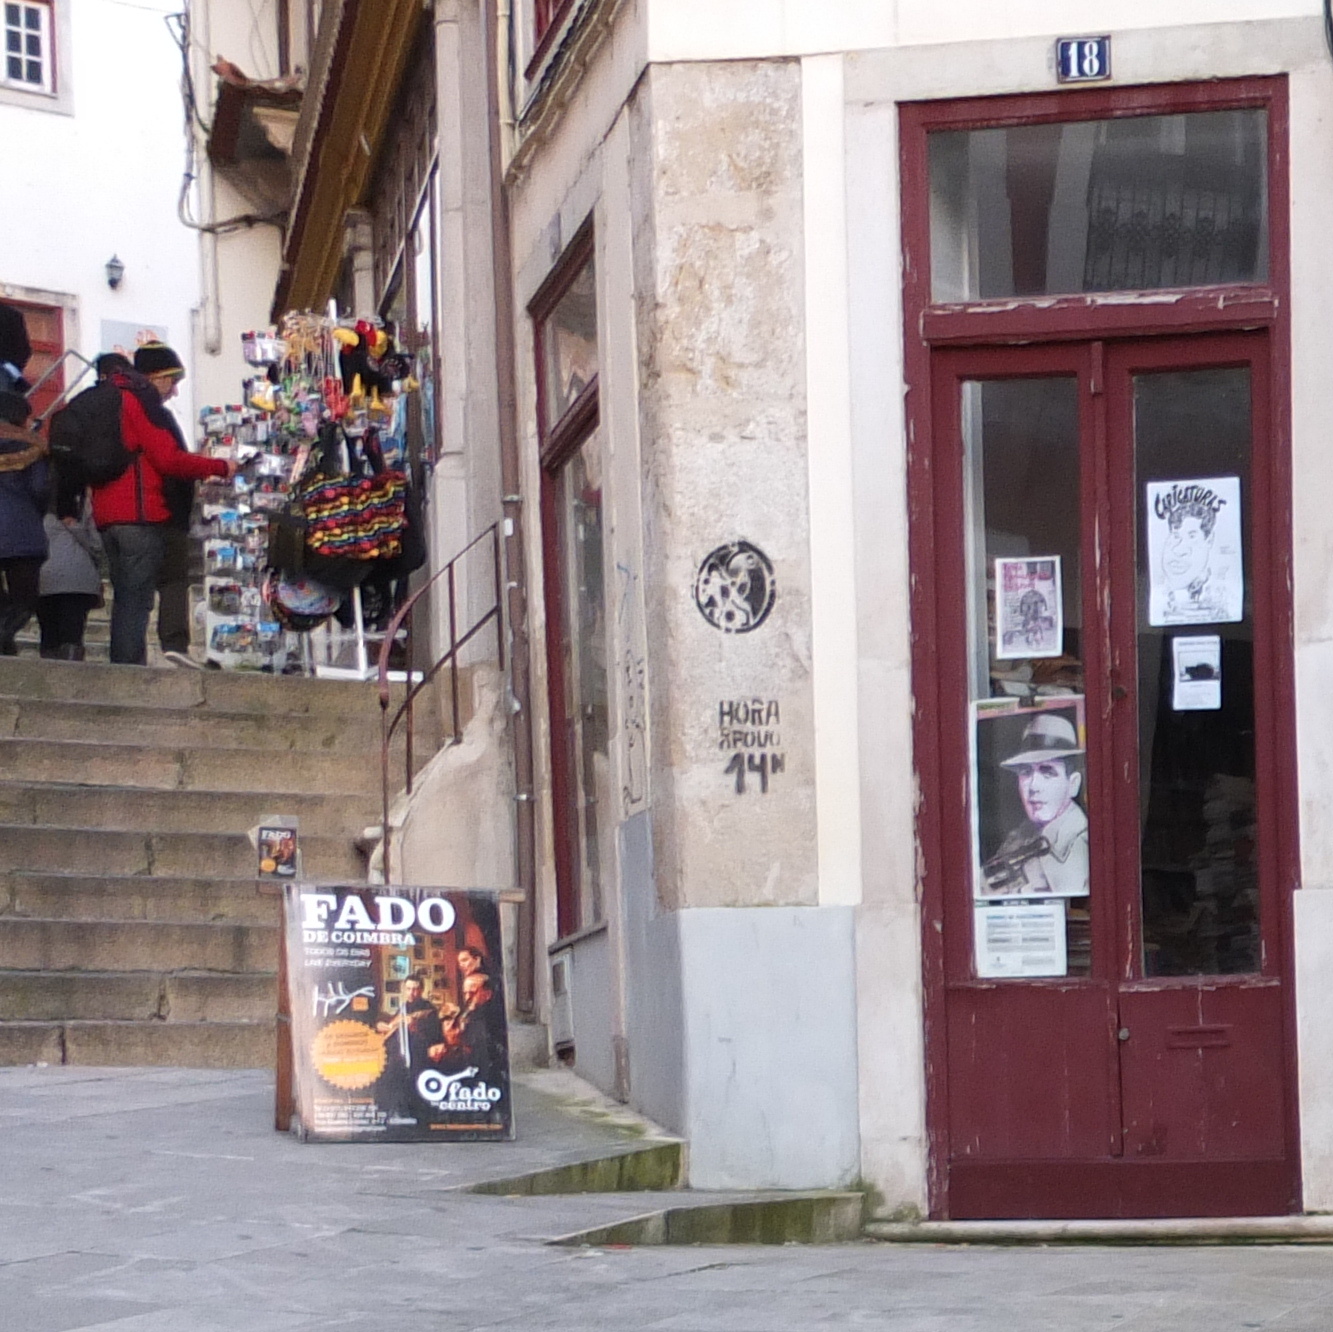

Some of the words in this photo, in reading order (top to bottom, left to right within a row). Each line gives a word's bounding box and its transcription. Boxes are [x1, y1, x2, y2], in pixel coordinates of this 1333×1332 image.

[1068, 41, 1100, 78] 18
[719, 697, 780, 727] HORA
[300, 893, 456, 933] FADO
[302, 930, 328, 943] DE
[330, 930, 416, 946] COIMBRA
[448, 1081, 502, 1101] fado
[438, 1098, 491, 1111] centro
